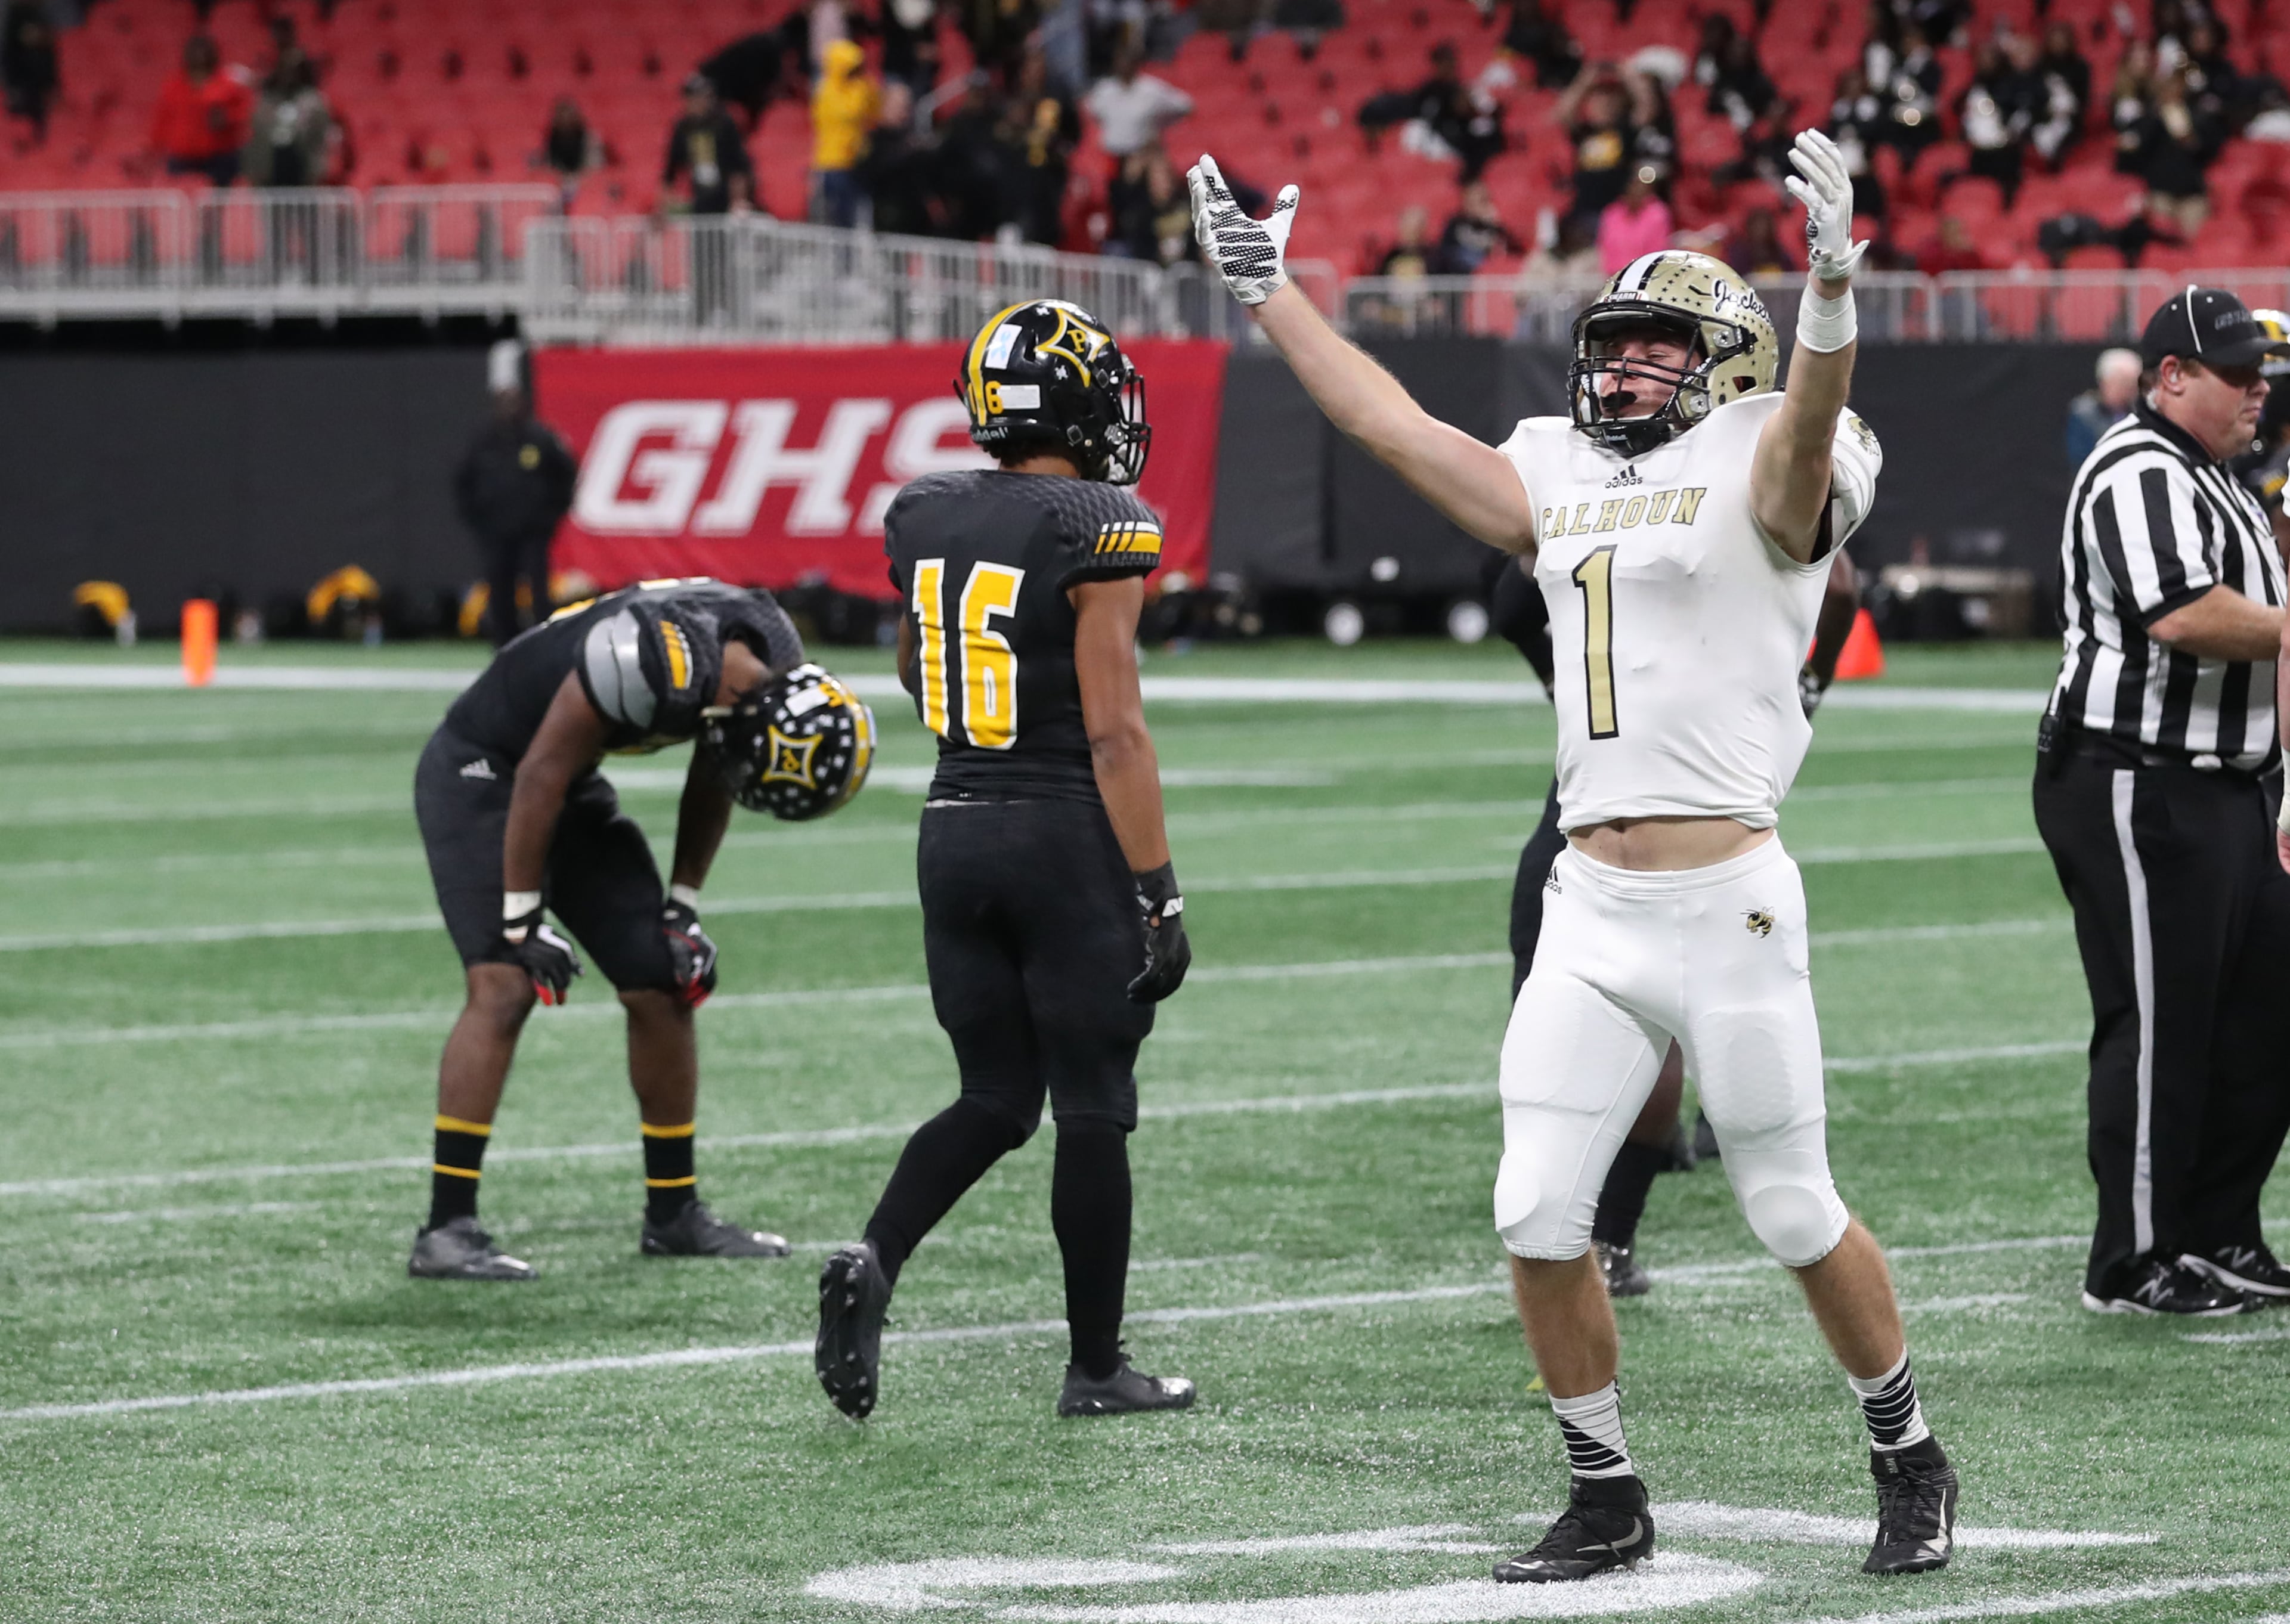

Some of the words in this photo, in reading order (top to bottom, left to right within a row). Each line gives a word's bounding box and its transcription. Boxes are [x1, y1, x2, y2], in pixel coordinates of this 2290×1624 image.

[1067, 329, 1087, 353] P
[1605, 476, 1643, 488] adidas
[1540, 488, 1707, 544] CALHOUN
[912, 557, 1026, 750] 16
[1571, 544, 1620, 740] 1
